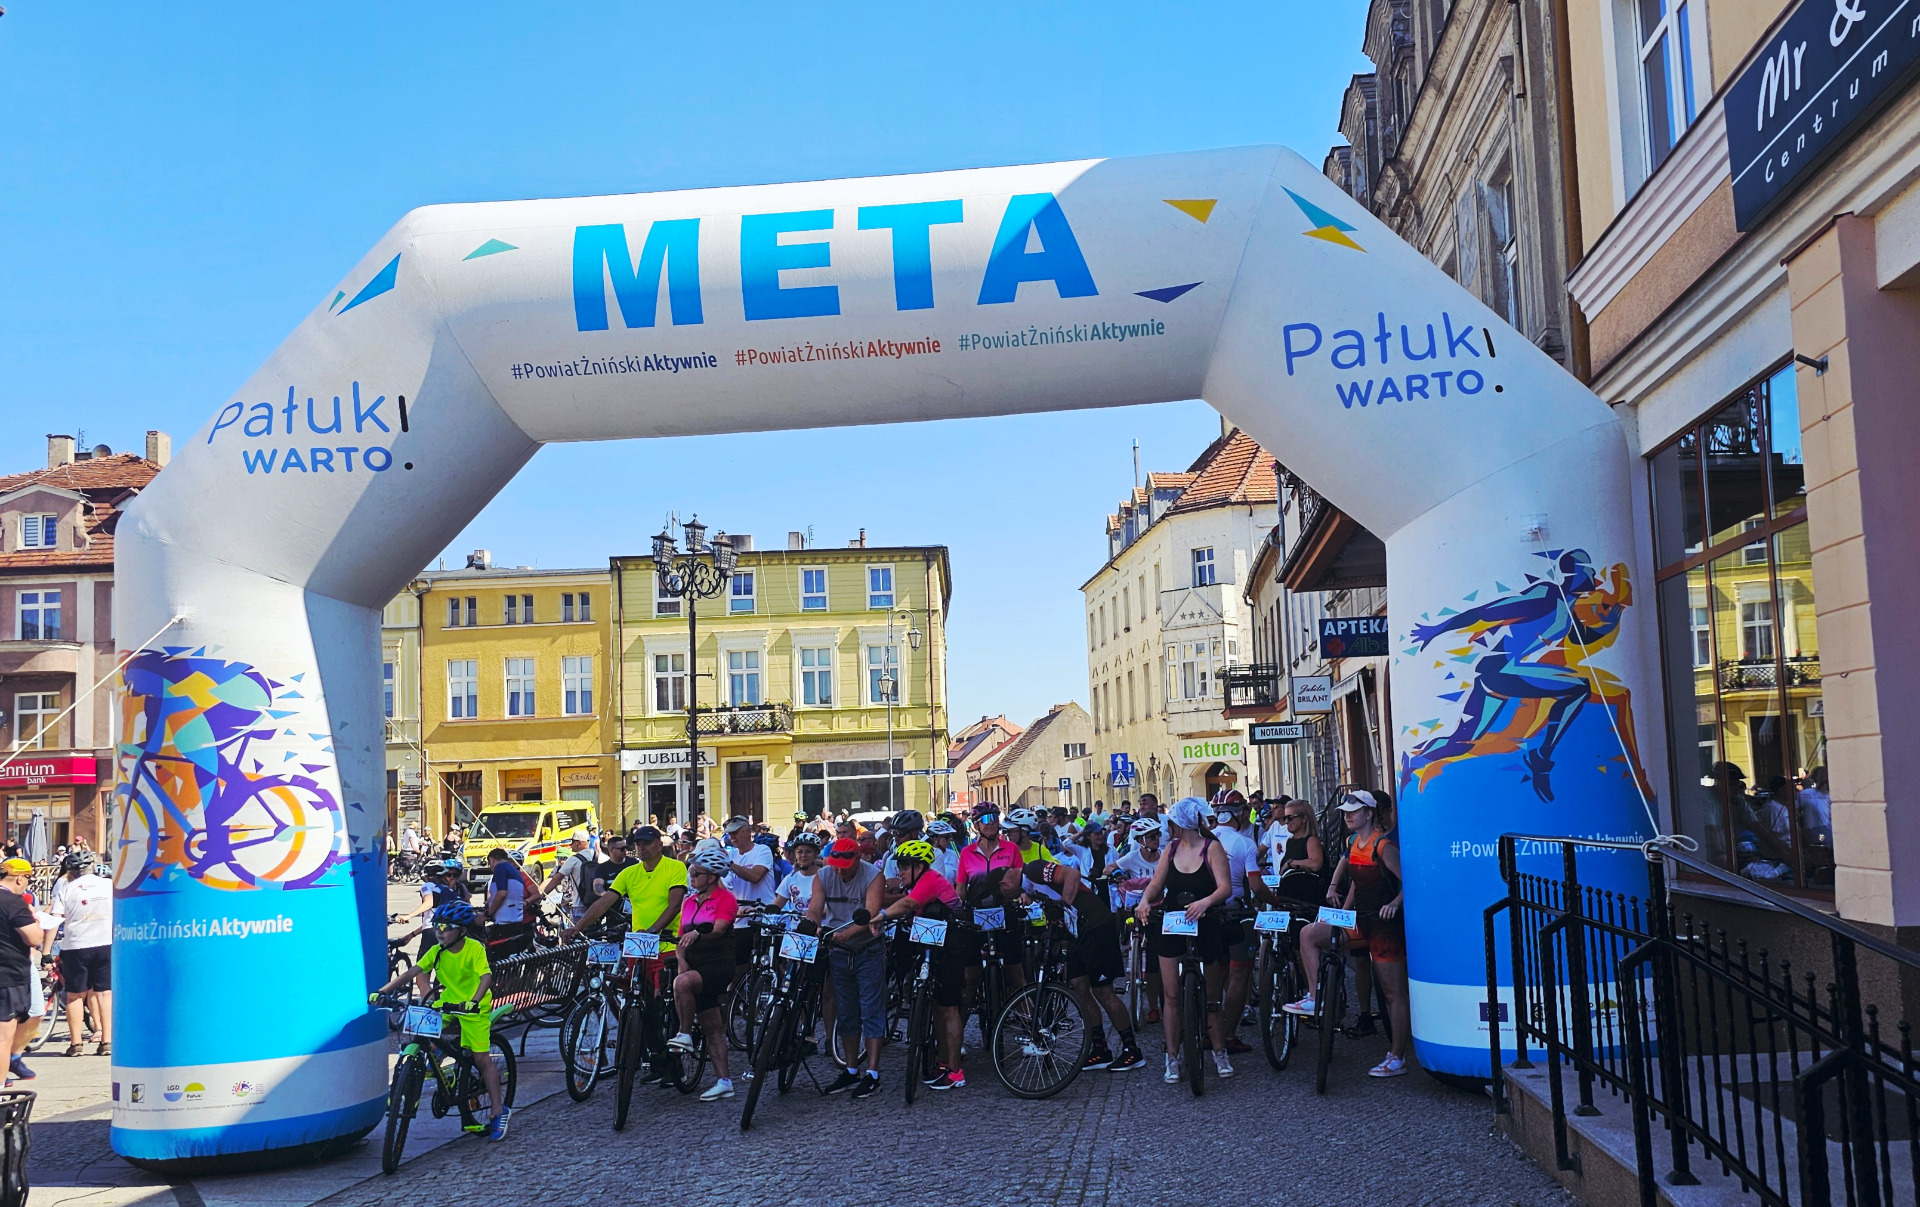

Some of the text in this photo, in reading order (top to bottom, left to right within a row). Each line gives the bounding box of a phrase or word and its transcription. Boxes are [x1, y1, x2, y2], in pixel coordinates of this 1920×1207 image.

[1757, 40, 1807, 132] Mr
[1765, 50, 1888, 183] Centrum
[572, 192, 1099, 331] META
[1298, 684, 1326, 695] Jubiler
[1260, 727, 1299, 737] NOTARIUSZ
[1183, 741, 1240, 759] natura
[638, 751, 707, 765] JUBILER
[27, 776, 47, 784] bank
[1268, 916, 1285, 925] 044
